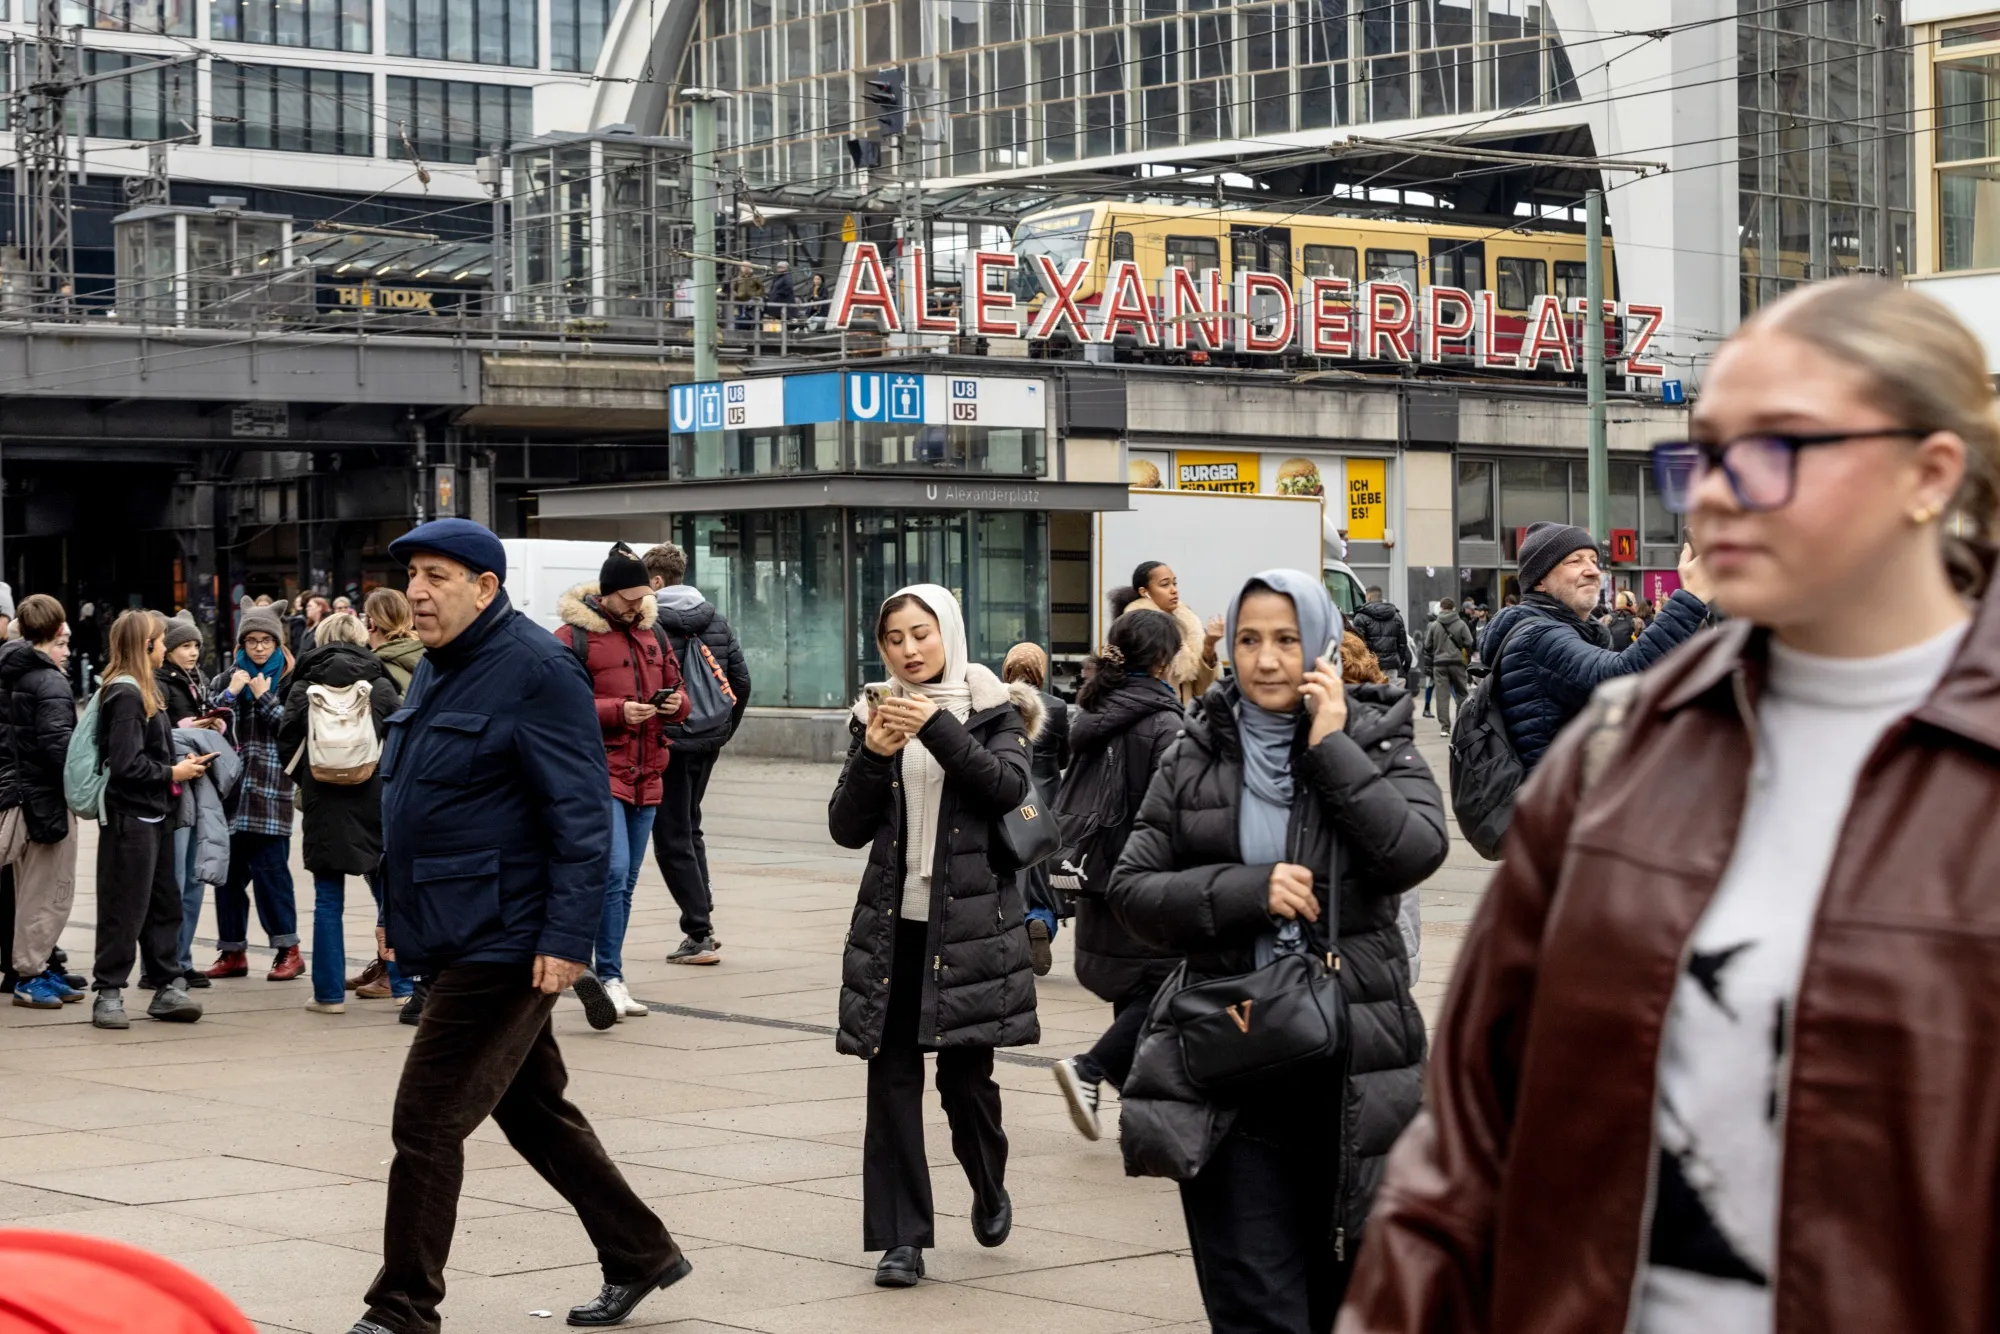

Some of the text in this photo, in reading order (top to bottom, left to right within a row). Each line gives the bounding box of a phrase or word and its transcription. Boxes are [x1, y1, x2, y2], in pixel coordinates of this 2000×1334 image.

[729, 386, 744, 402] U8
[851, 375, 881, 419] U
[954, 382, 975, 397] U8
[673, 388, 694, 430] U
[729, 408, 744, 424] U5
[955, 404, 976, 420] U5
[1180, 464, 1237, 482] BURGER
[1350, 480, 1369, 492] ICH
[926, 484, 1040, 506] U Alexanderplatz
[1350, 492, 1382, 505] LIEBE
[1351, 507, 1369, 520] ES!
